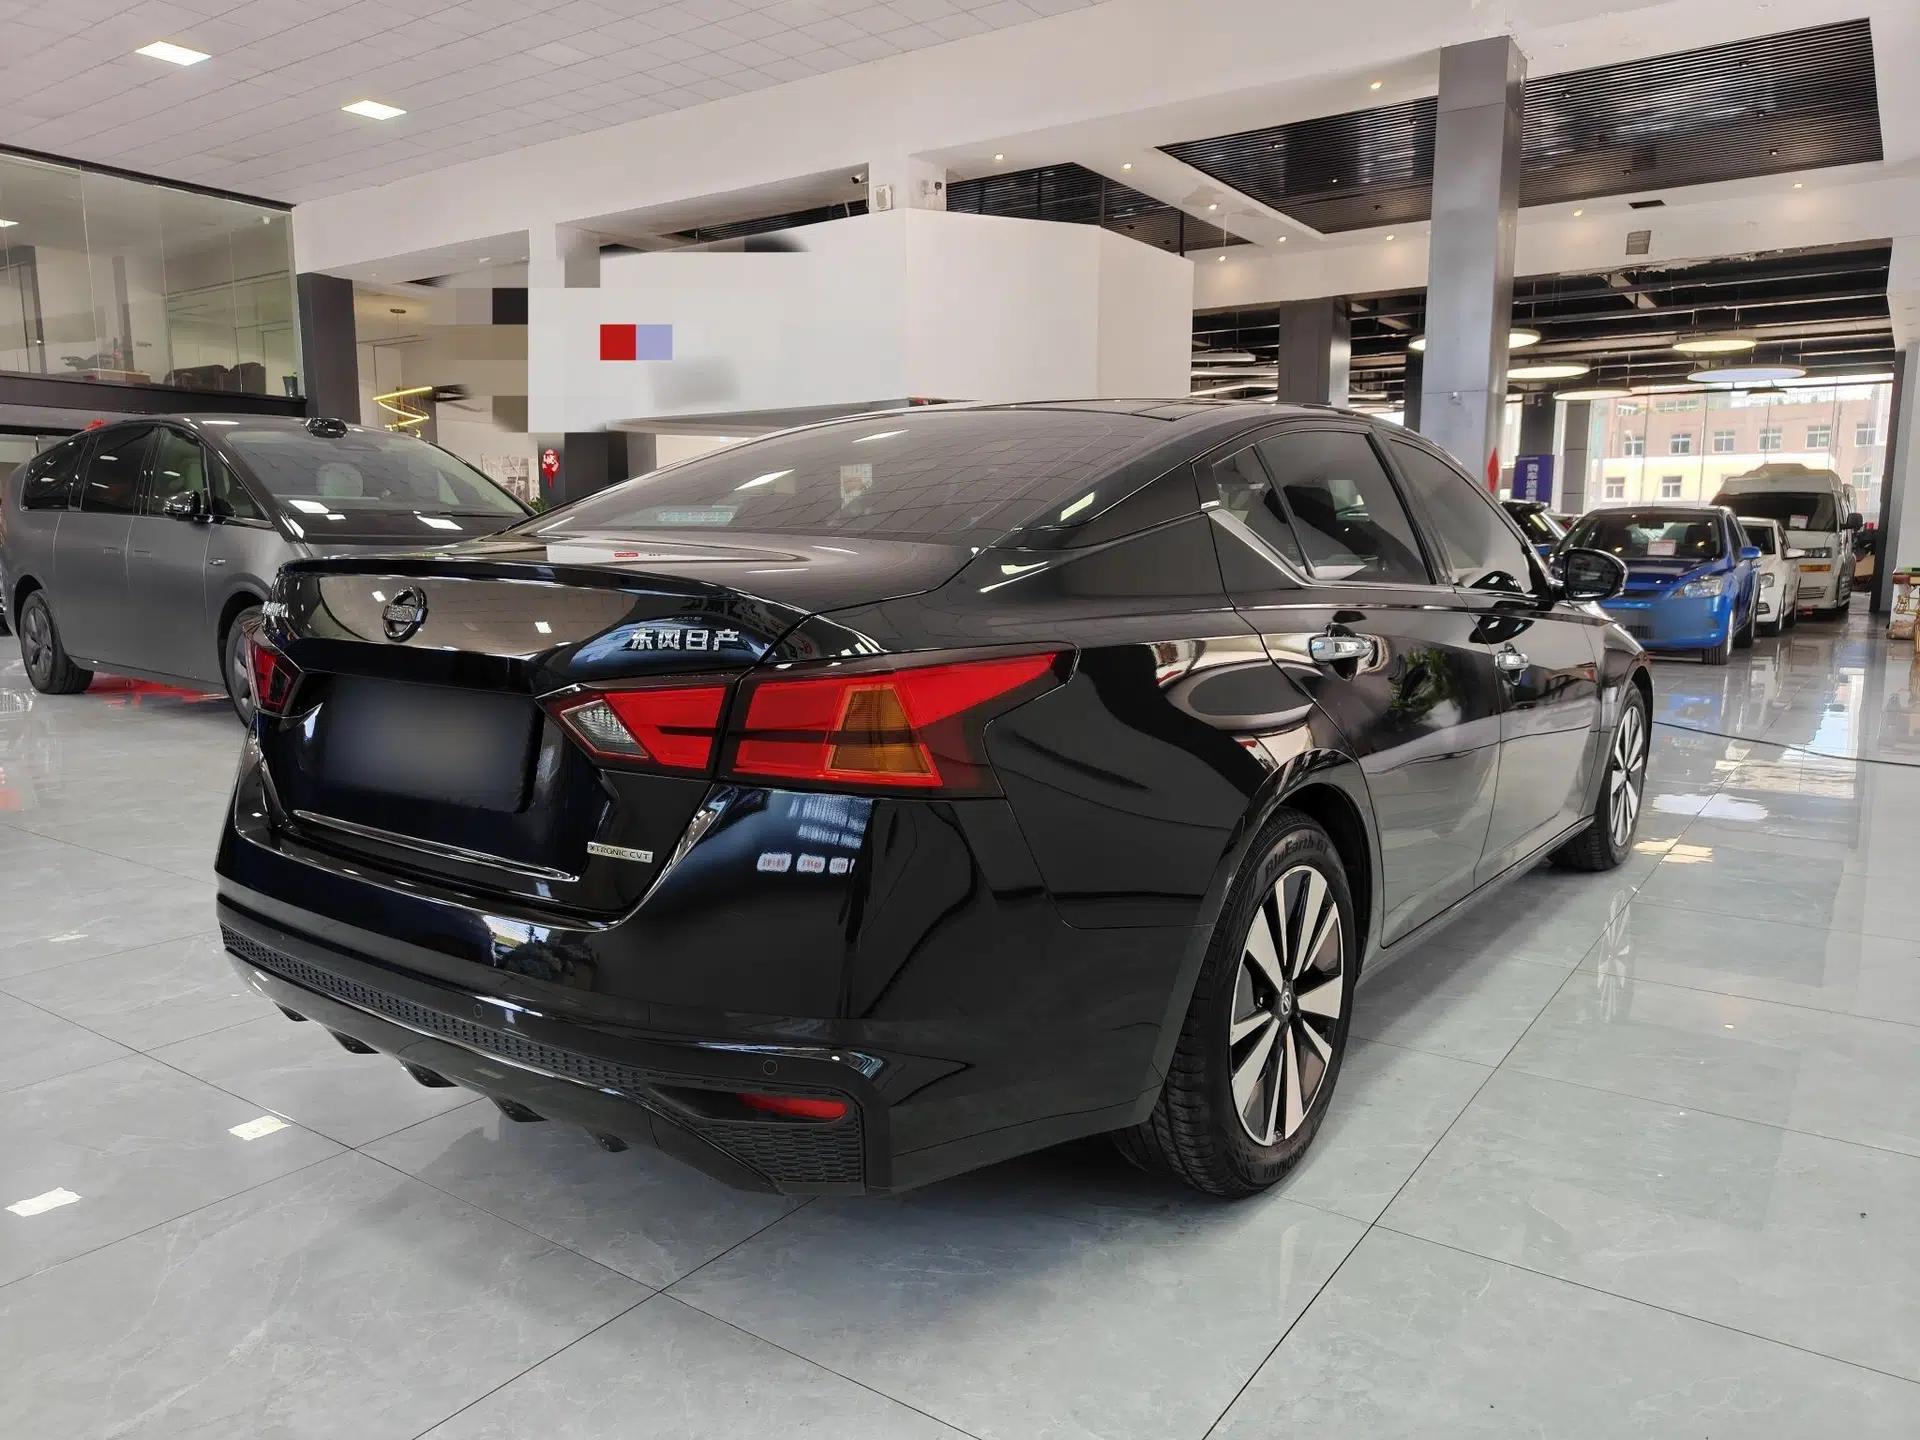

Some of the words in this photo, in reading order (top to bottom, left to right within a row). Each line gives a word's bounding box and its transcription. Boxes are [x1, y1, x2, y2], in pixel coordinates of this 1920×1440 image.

[630, 628, 740, 651] 东风日产
[588, 844, 627, 857] XTRONIC
[629, 851, 650, 860] CVT
